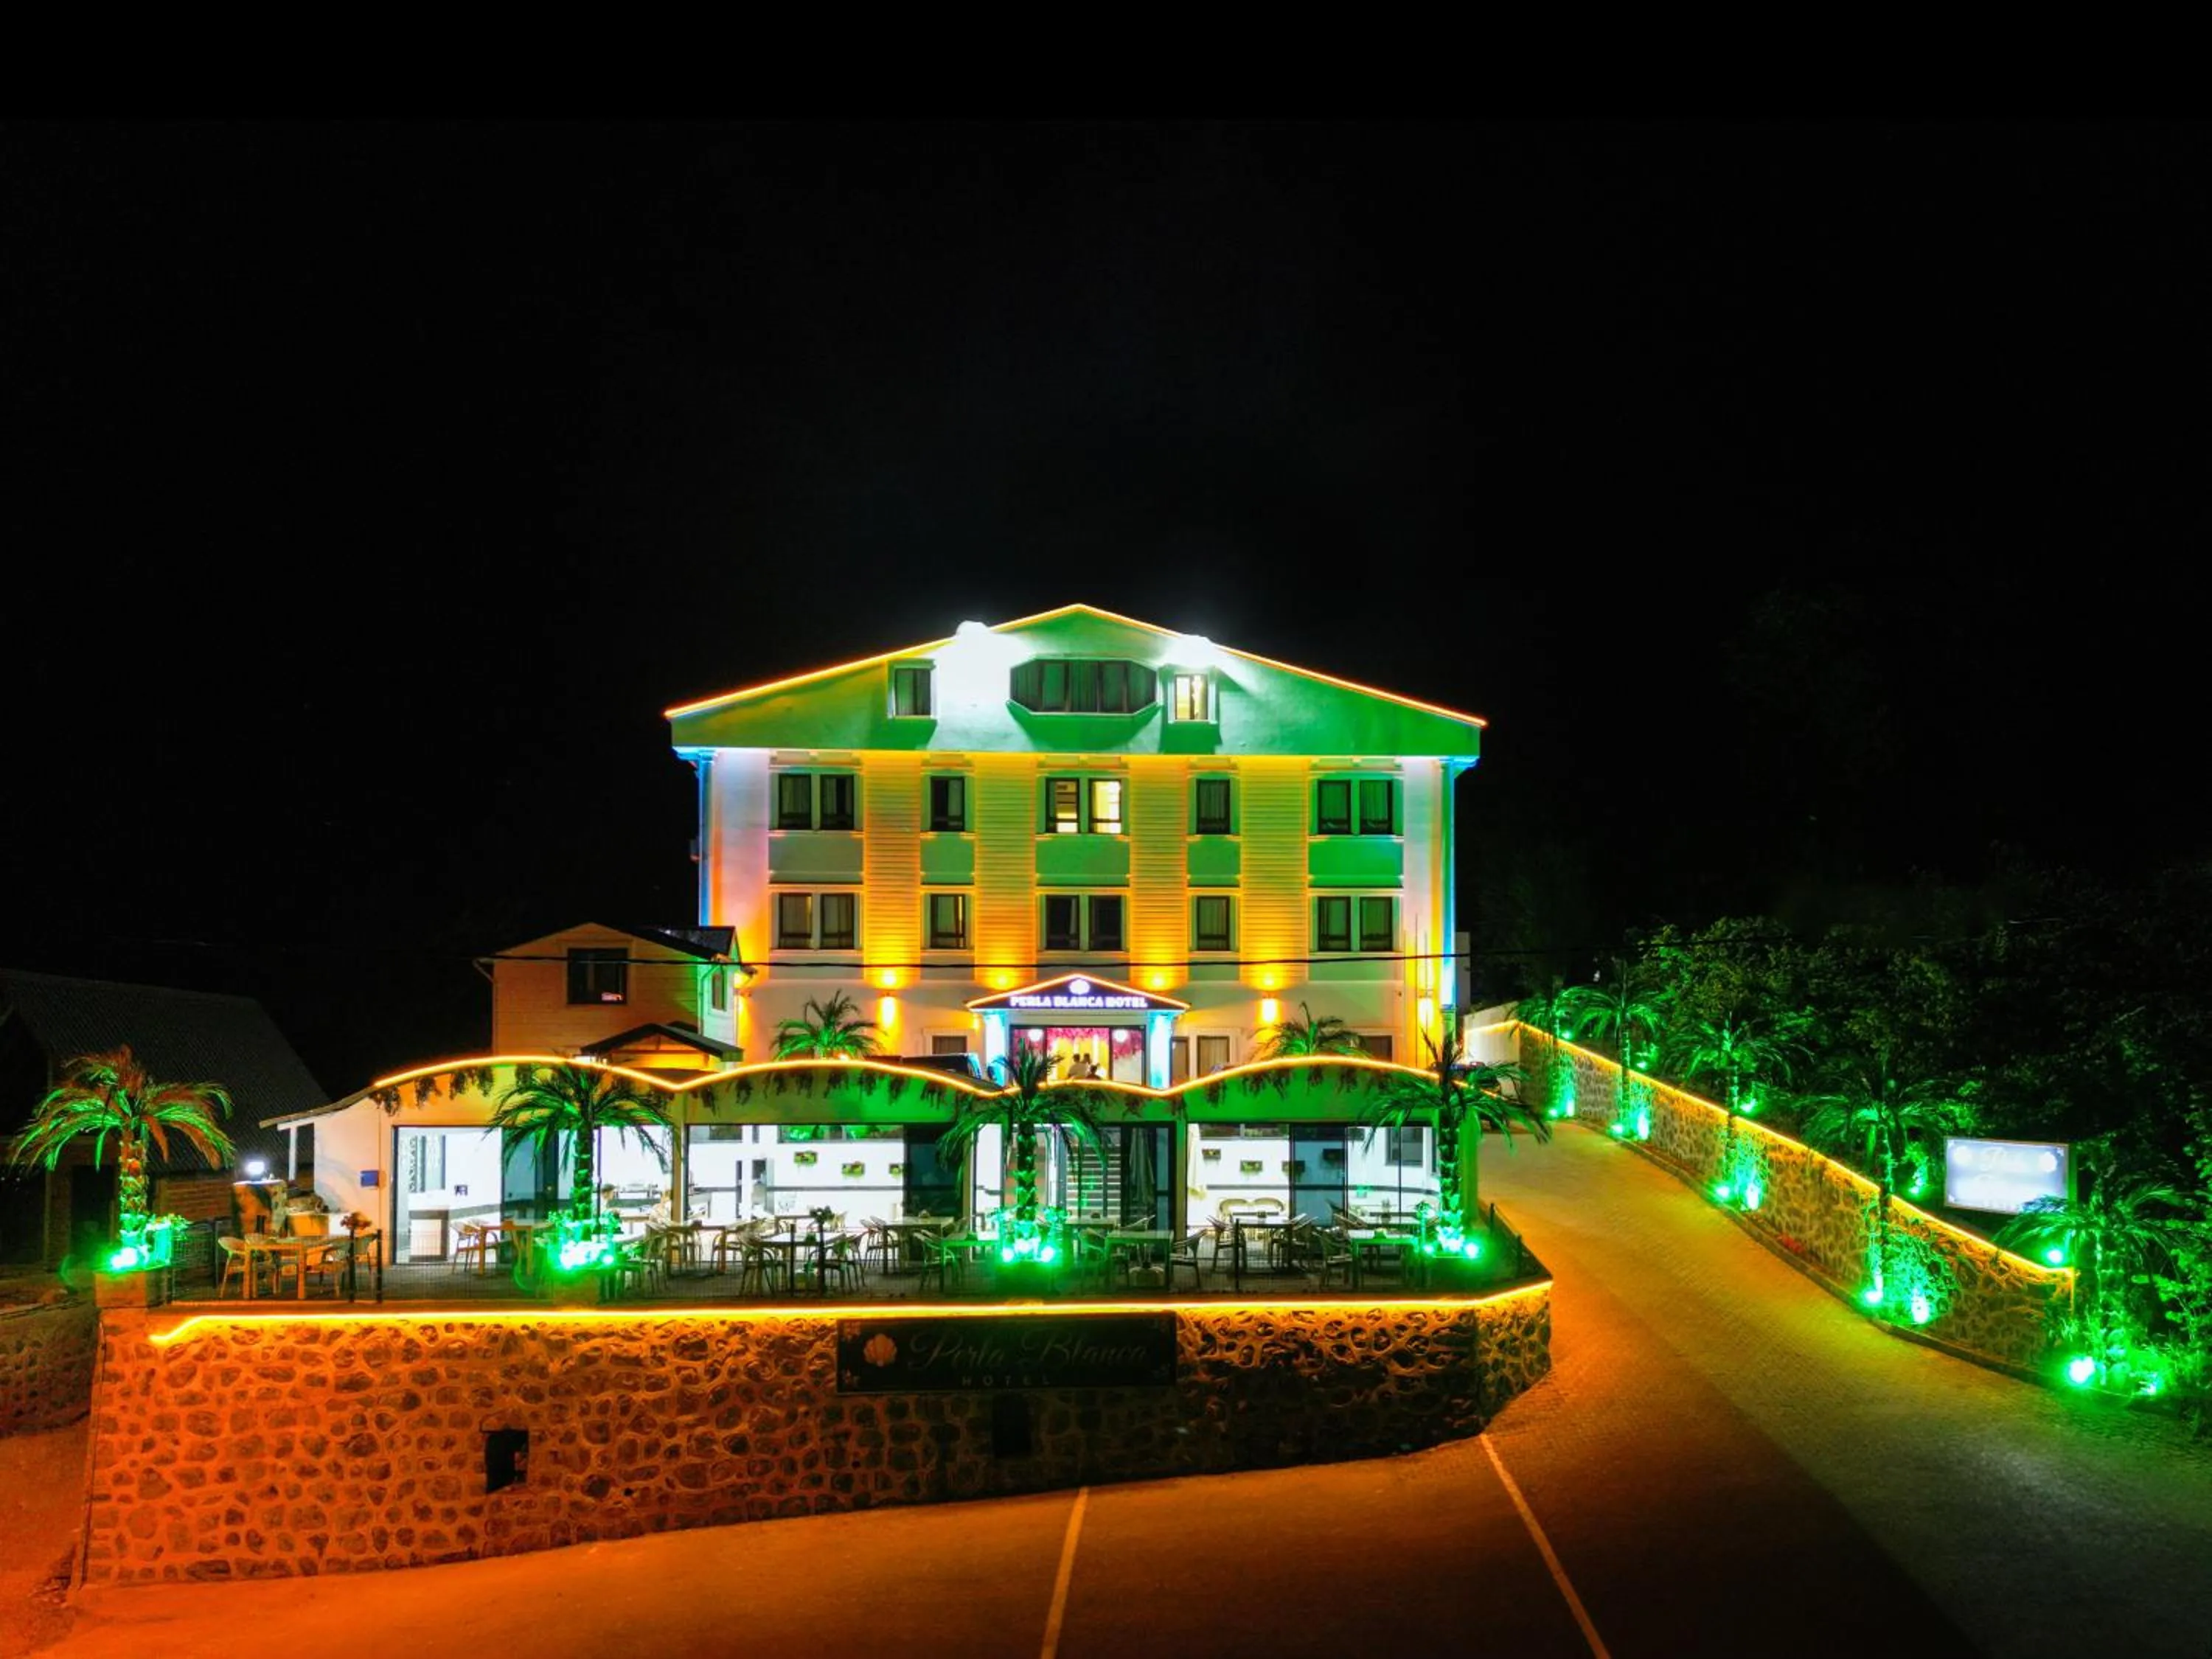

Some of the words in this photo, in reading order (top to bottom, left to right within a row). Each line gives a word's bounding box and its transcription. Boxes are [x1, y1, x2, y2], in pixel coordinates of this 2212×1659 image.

[1009, 995, 1051, 1007] PERLA
[1053, 996, 1104, 1008] BLANCA
[1105, 996, 1148, 1008] HOTEL
[908, 1328, 1005, 1370] Perla
[1018, 1328, 1148, 1370] Blanca
[961, 1374, 1050, 1387] HOTEL
